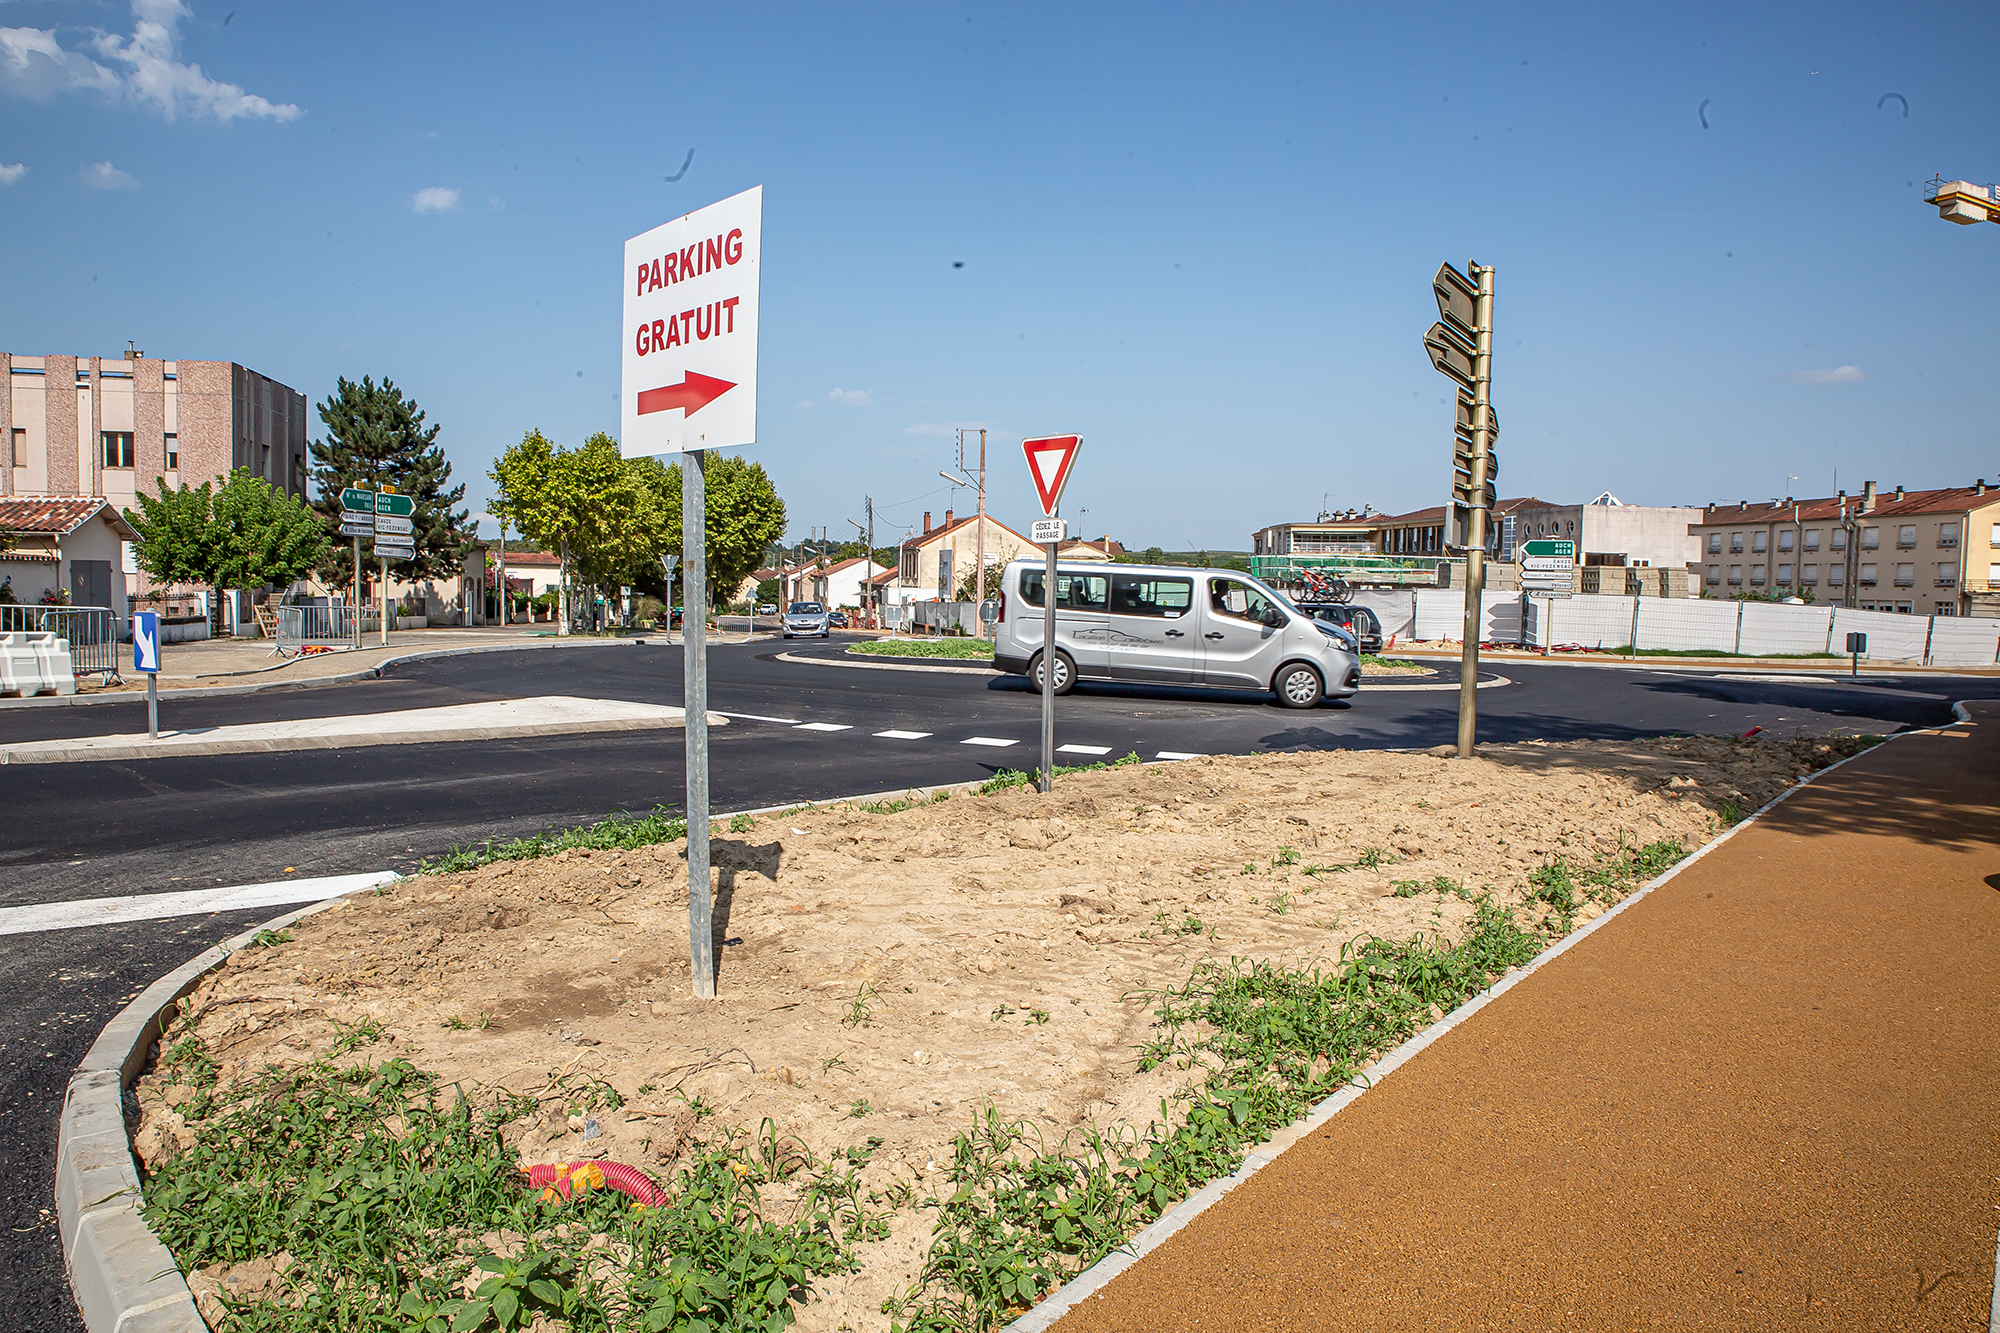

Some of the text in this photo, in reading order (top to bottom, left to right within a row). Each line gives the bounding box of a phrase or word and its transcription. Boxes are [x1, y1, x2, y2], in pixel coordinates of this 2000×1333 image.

[637, 228, 743, 297] PARKING
[636, 296, 739, 357] GRATUIT
[1036, 522, 1050, 530] CÉDEZ
[1036, 531, 1059, 539] PASSAGE
